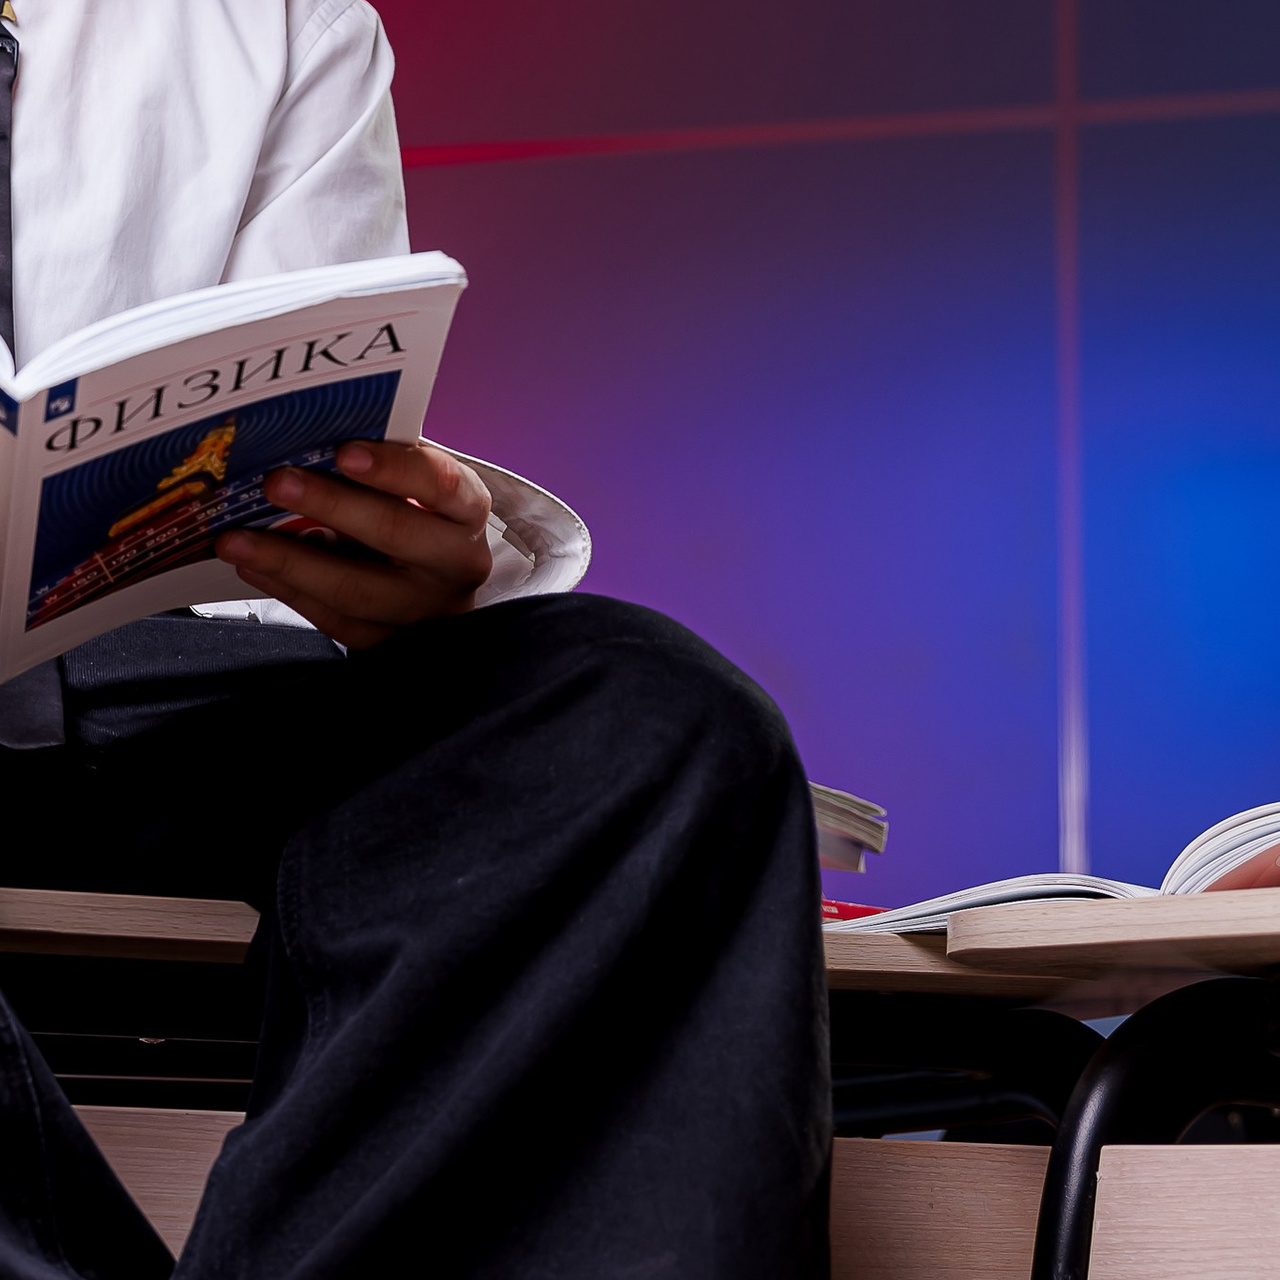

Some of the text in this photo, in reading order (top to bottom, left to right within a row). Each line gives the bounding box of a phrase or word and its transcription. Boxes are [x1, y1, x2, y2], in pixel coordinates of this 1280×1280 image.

[45, 322, 407, 454] ФИЗИКА
[111, 548, 137, 566] 170
[145, 526, 179, 548] 200
[238, 487, 264, 502] 30
